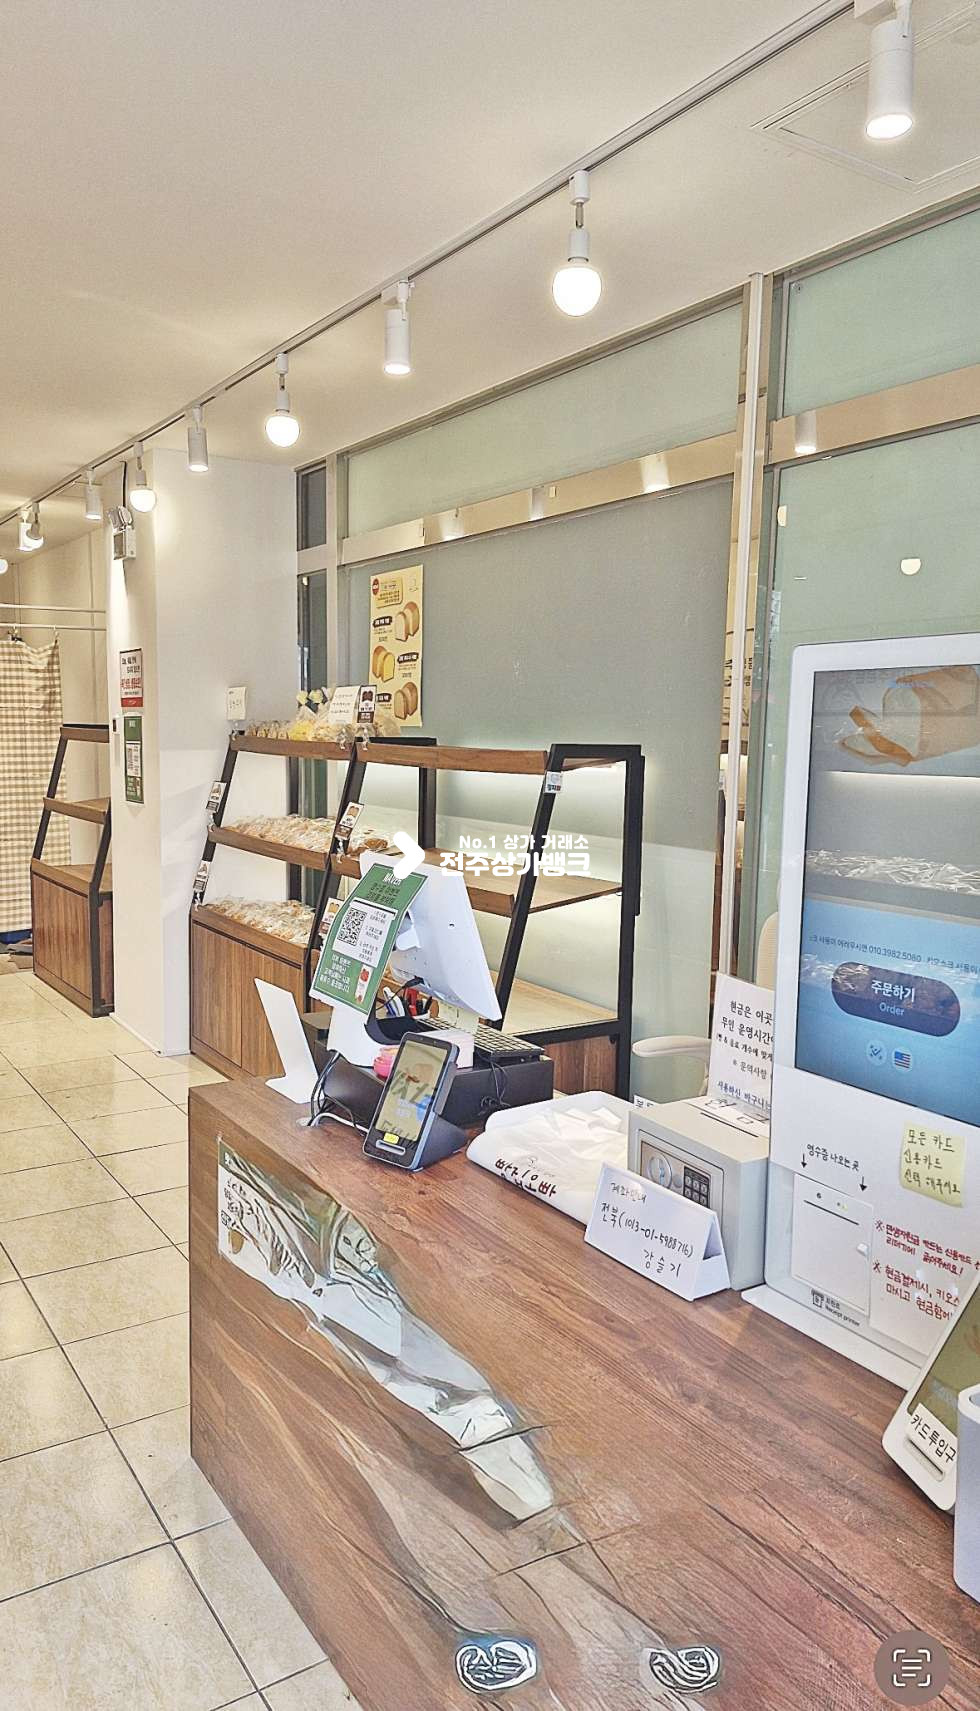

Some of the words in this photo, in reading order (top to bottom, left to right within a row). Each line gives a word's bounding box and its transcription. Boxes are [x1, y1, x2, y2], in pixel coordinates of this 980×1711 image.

[871, 979, 916, 1002] 주문하기
[730, 1001, 752, 1019] 현금은
[879, 1002, 905, 1016] Order
[721, 1016, 735, 1032] 무인
[907, 1129, 926, 1147] 모든
[933, 1134, 954, 1153] 카드
[806, 1143, 829, 1162] 영수증
[830, 1152, 851, 1169] 나오는
[852, 1160, 860, 1171] 곳
[903, 1149, 943, 1170] 신용카드
[886, 1236, 916, 1257] 리더기에
[886, 1283, 911, 1302] 마시고
[911, 1414, 956, 1463] 카드투입구
